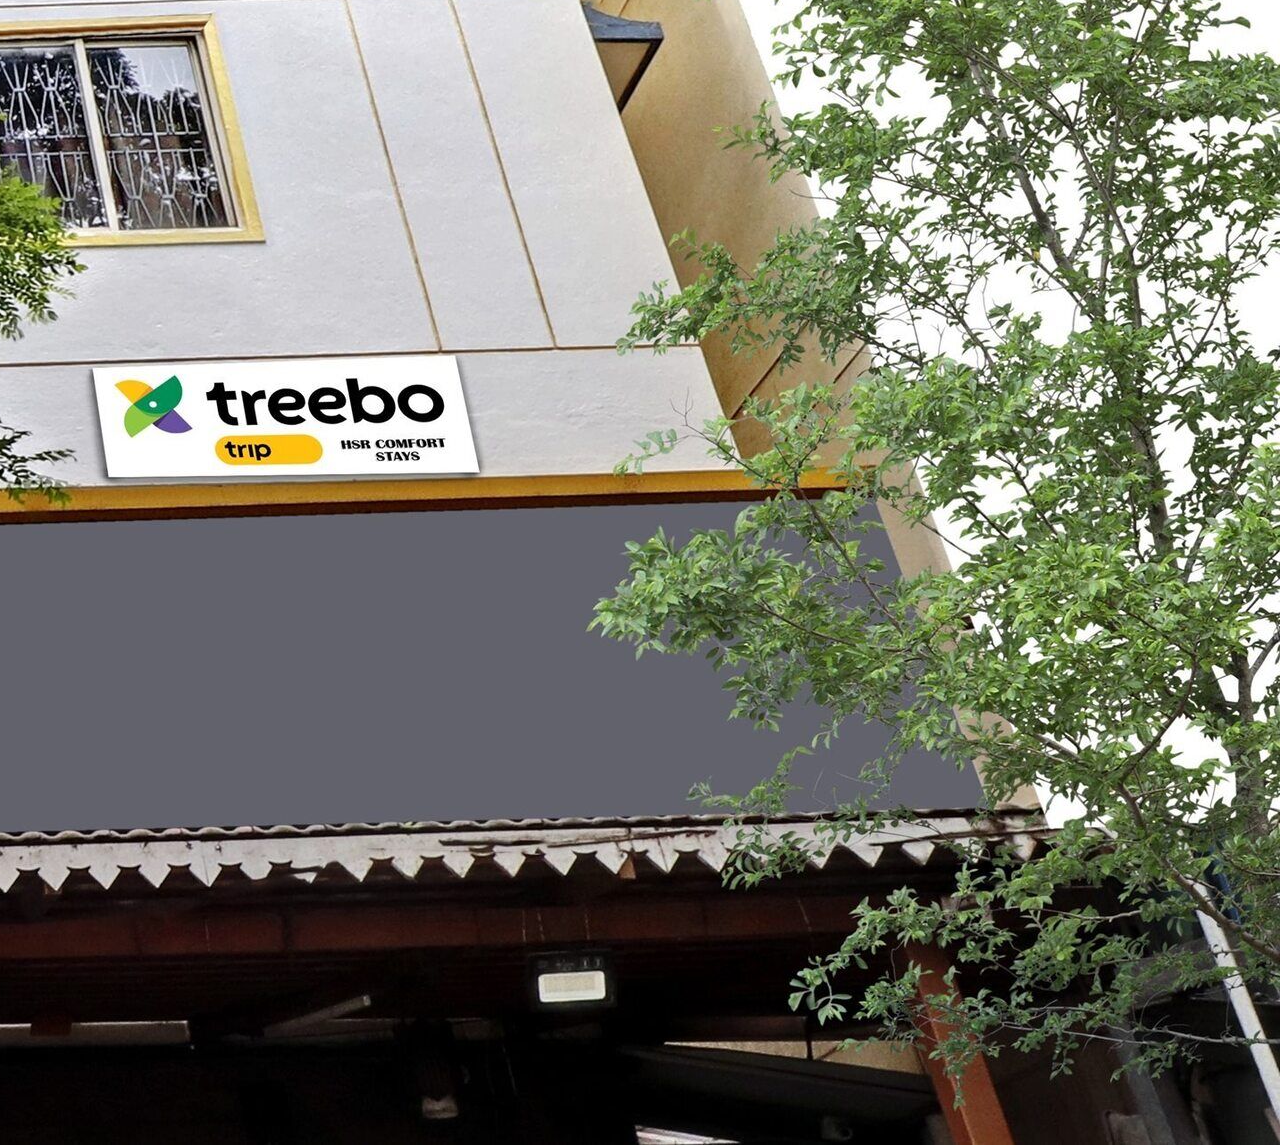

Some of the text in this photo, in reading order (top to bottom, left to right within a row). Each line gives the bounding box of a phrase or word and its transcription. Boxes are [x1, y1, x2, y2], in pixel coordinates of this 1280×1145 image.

[206, 378, 444, 425] treebo
[224, 441, 272, 461] trip
[340, 437, 445, 450] HSR COMFORT
[375, 451, 421, 462] STAYS
